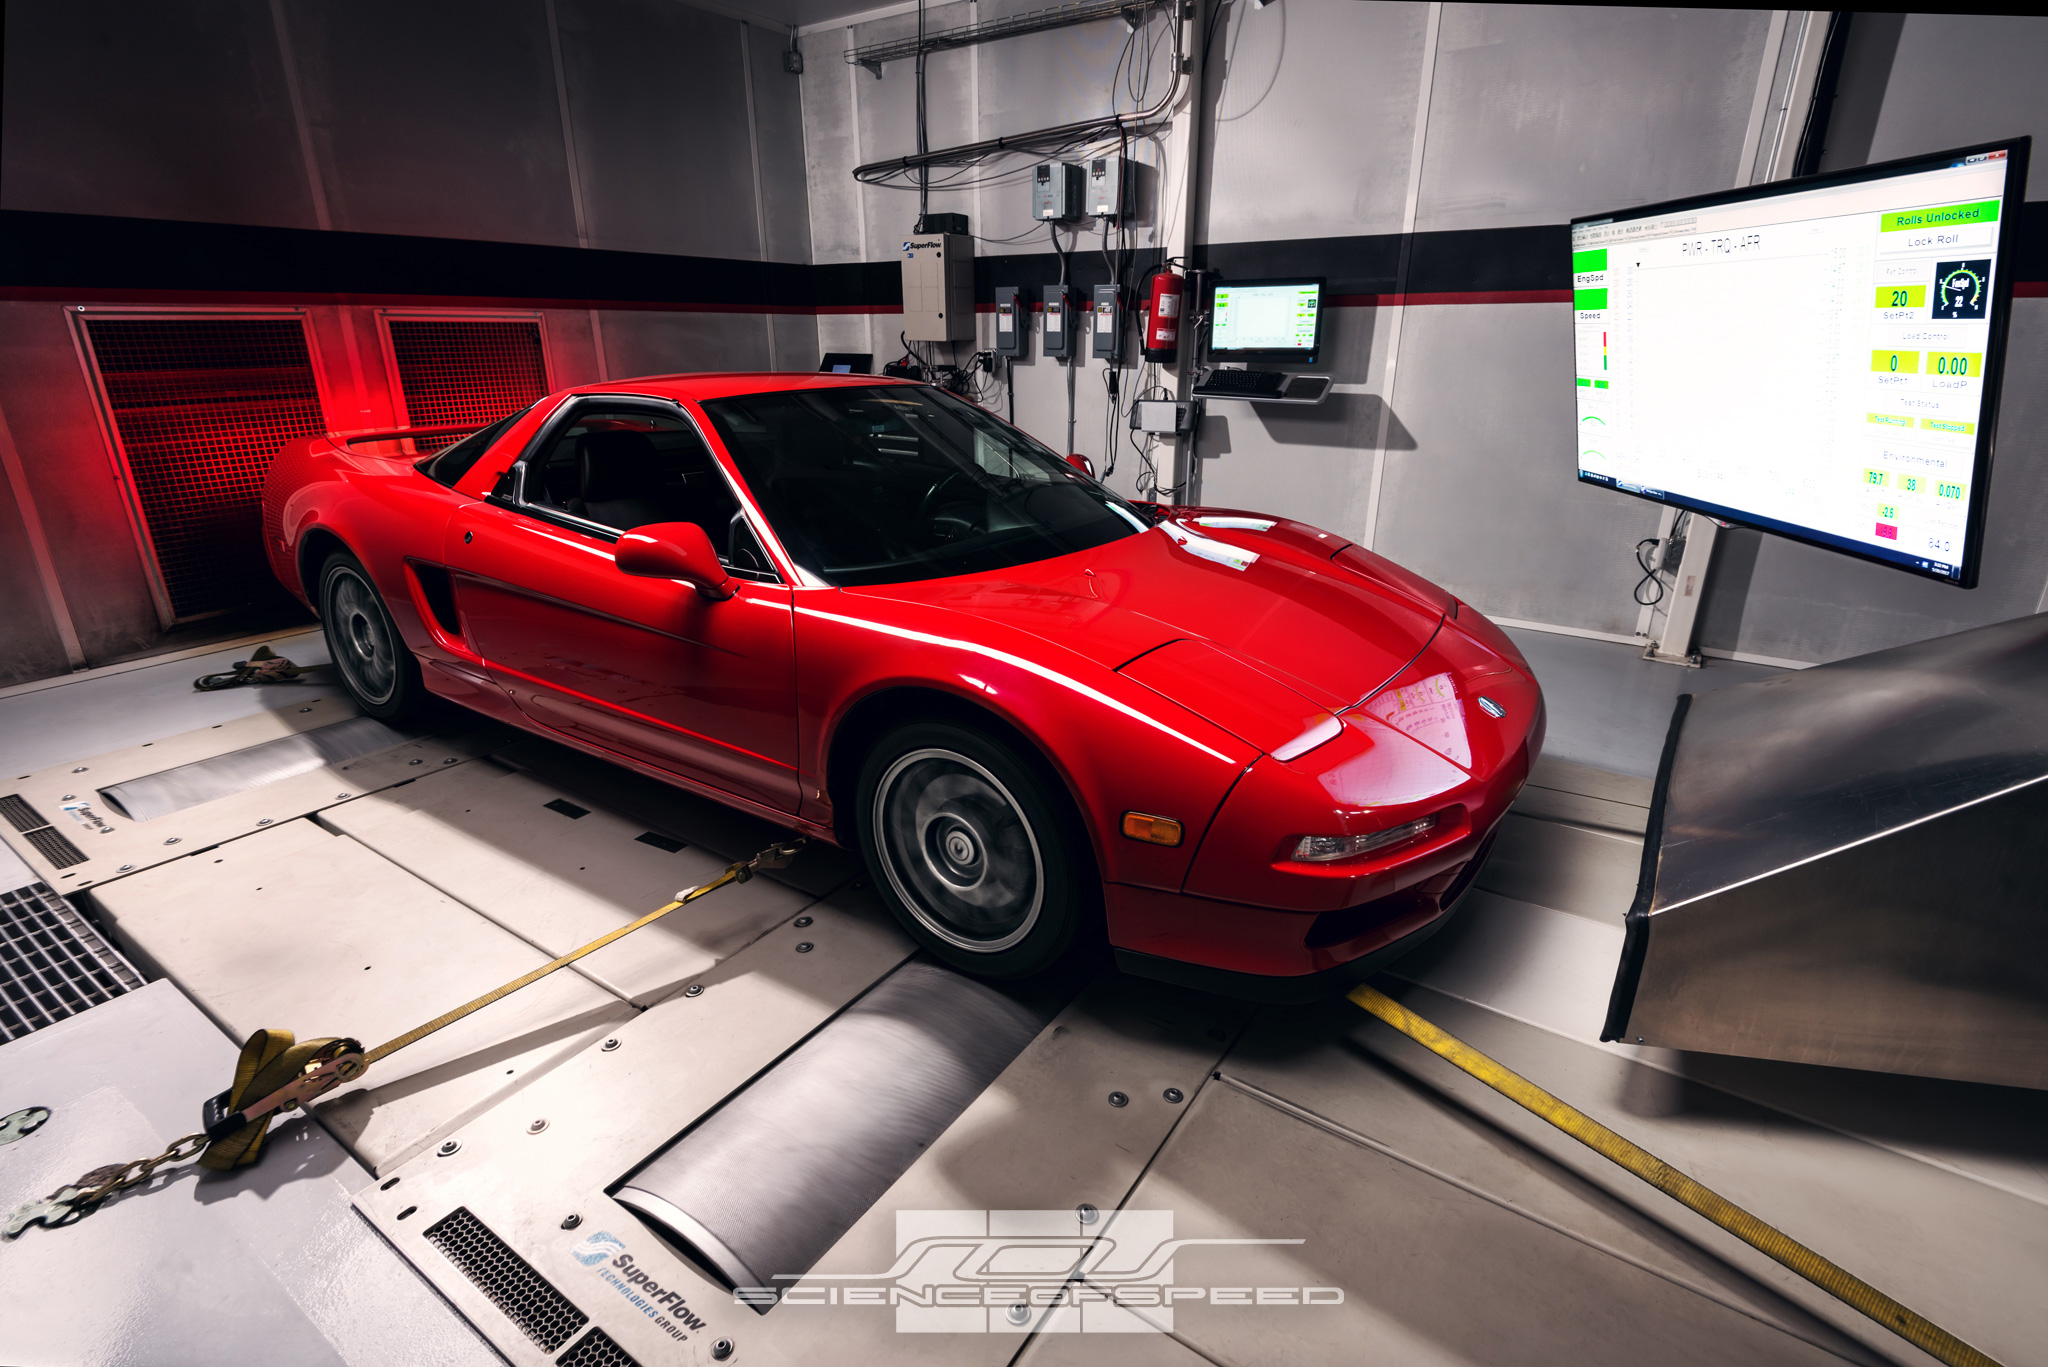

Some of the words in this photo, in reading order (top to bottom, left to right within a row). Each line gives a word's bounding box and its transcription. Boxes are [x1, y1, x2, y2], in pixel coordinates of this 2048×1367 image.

[1897, 215, 1923, 226] Rolls
[1926, 208, 1980, 223] Unlocked
[910, 241, 942, 250] SuperFlow
[1682, 241, 1703, 258] PWR
[1711, 237, 1732, 254] TRQ
[1739, 234, 1762, 252] AFR
[1907, 235, 1933, 248] Lock
[1936, 234, 1959, 245] Roll
[1577, 274, 1604, 284] EngSpd
[1891, 290, 1908, 307] 20
[1579, 312, 1601, 321] Speed
[1883, 311, 1915, 320] SetPt2
[1902, 331, 1921, 340] Load
[1922, 332, 1951, 341] Control
[1890, 354, 1898, 372] 0
[1937, 356, 1968, 376] 0.00
[1877, 375, 1909, 386] SetPt1
[1932, 379, 1968, 389] LoadP
[1900, 398, 1915, 407] Test
[1916, 400, 1940, 409] Status
[1874, 415, 1886, 424] Test
[1930, 421, 1942, 430] Test
[1943, 422, 1966, 433] Stopped
[1882, 450, 1949, 469] Environmental
[1868, 471, 1884, 486] 79.7
[1906, 478, 1917, 492] 38
[1938, 483, 1962, 500] 0.070
[1927, 536, 1951, 553] 84.0
[612, 1253, 707, 1332] SuperFlow
[596, 1265, 659, 1319] TECHNOLOGIES
[654, 1315, 688, 1342] GROUP
